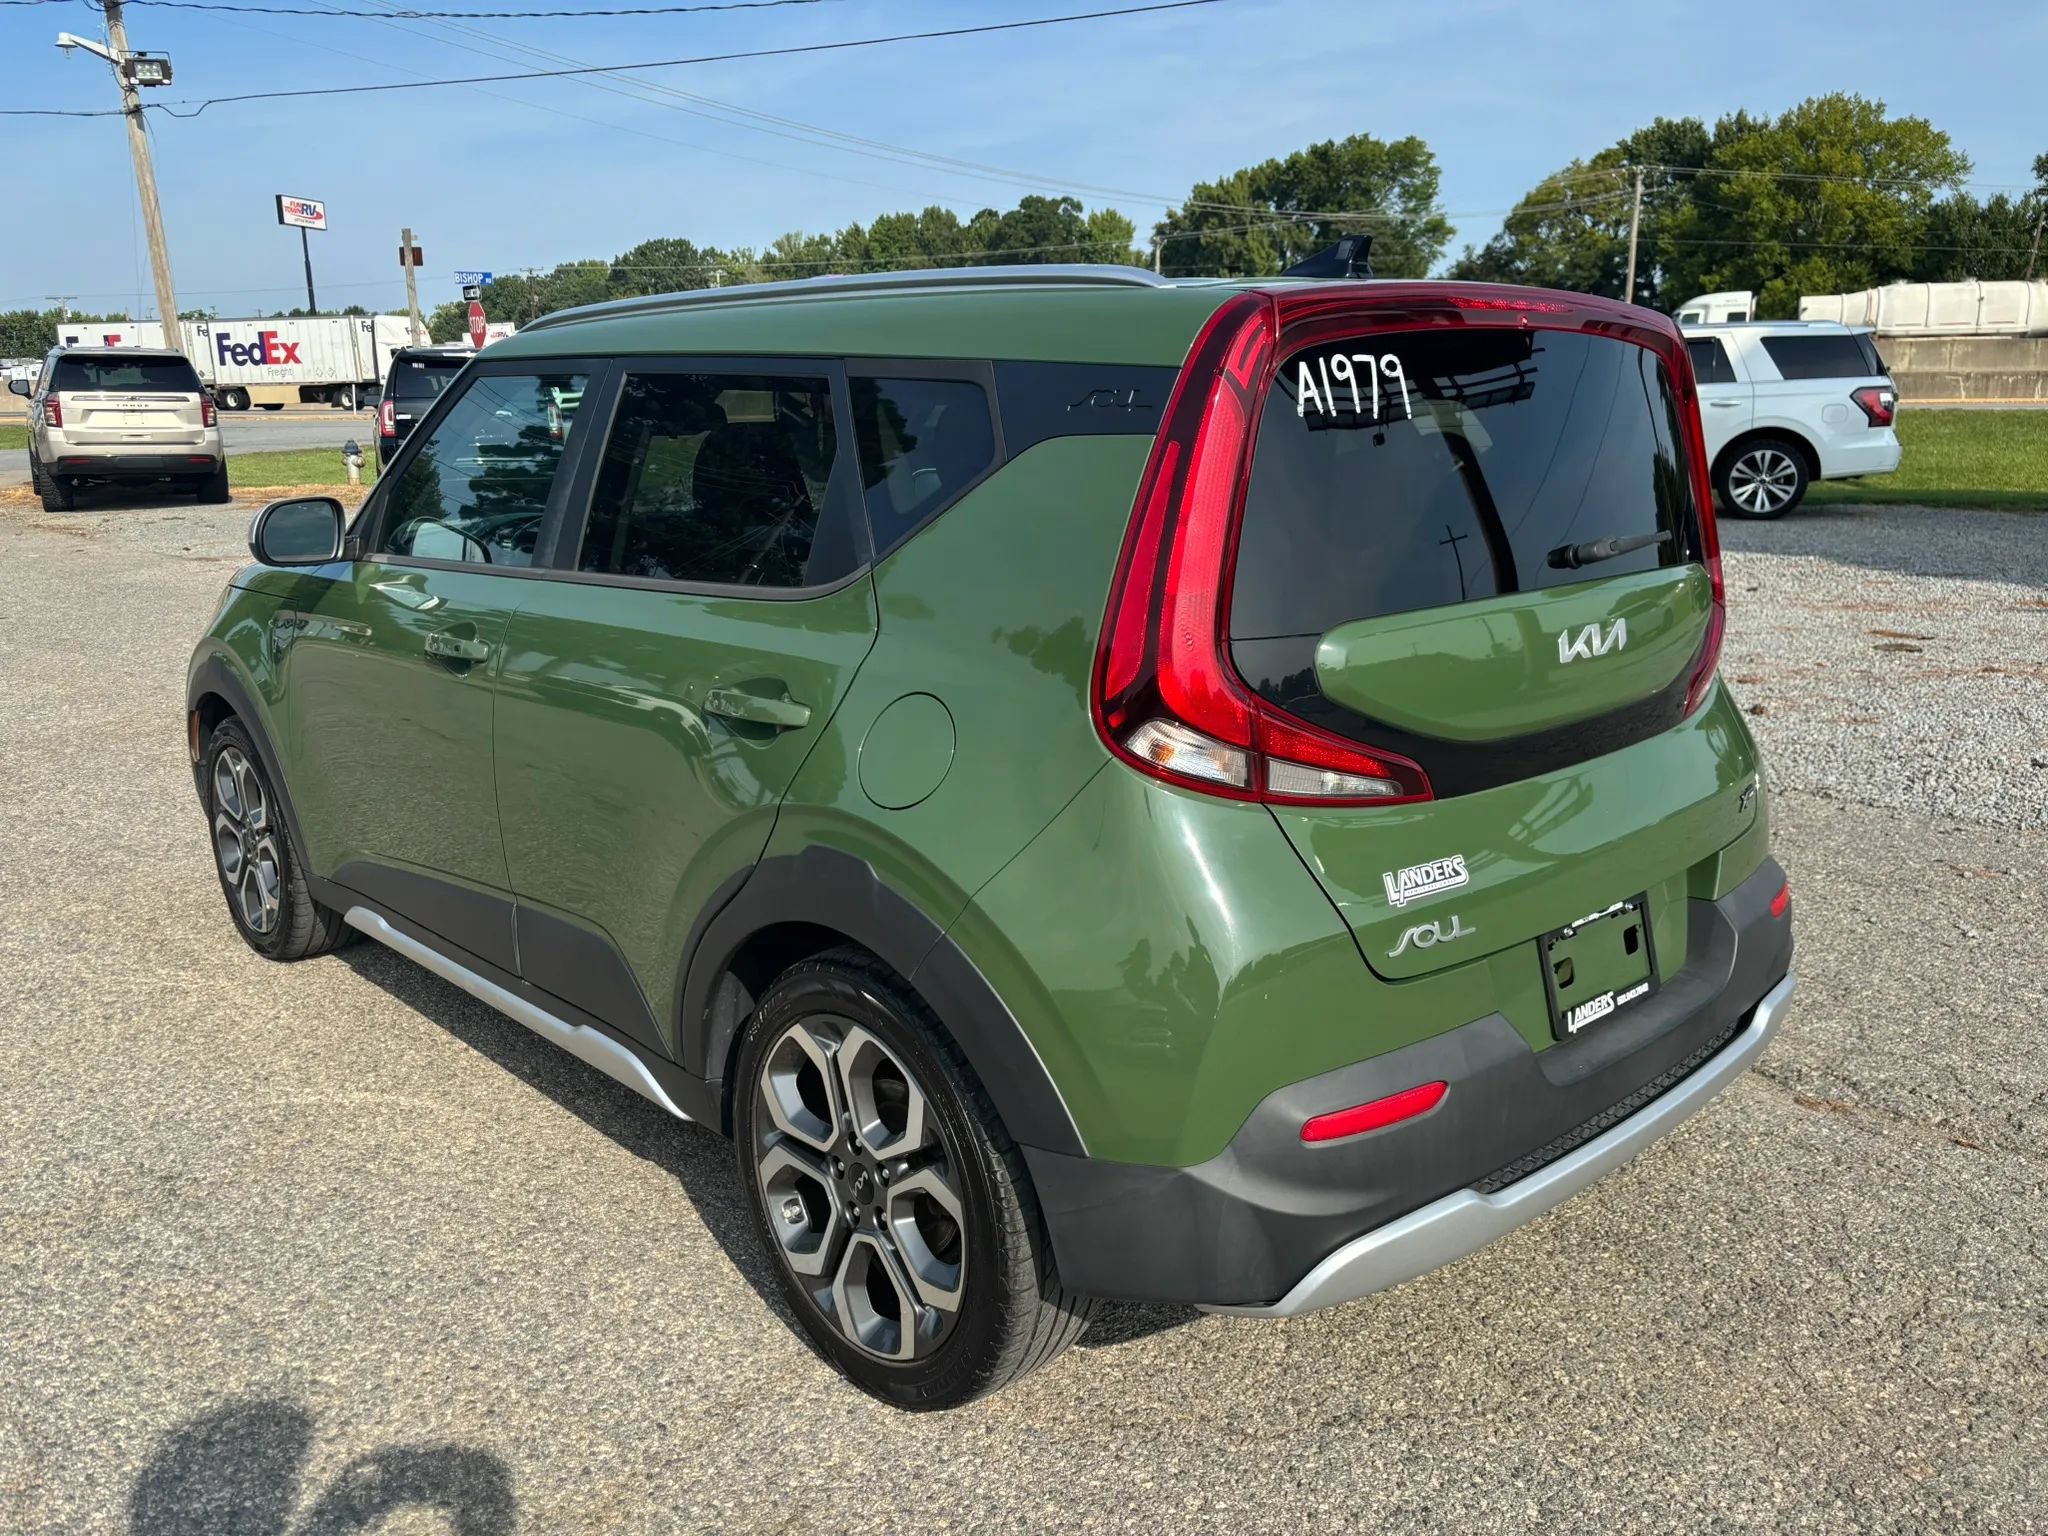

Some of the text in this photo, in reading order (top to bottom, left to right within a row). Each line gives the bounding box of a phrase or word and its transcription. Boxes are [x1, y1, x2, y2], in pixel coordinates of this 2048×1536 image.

[301, 203, 317, 216] RV
[454, 272, 483, 284] BISHOP
[469, 316, 485, 334] STOP
[215, 330, 303, 367] FedEx
[267, 367, 295, 378] Freight
[1297, 353, 1413, 420] A1979
[1557, 617, 1628, 664] KIA
[1384, 855, 1468, 905] LANDERS
[1384, 915, 1476, 958] SOUL
[1567, 990, 1615, 1034] LANDERS
